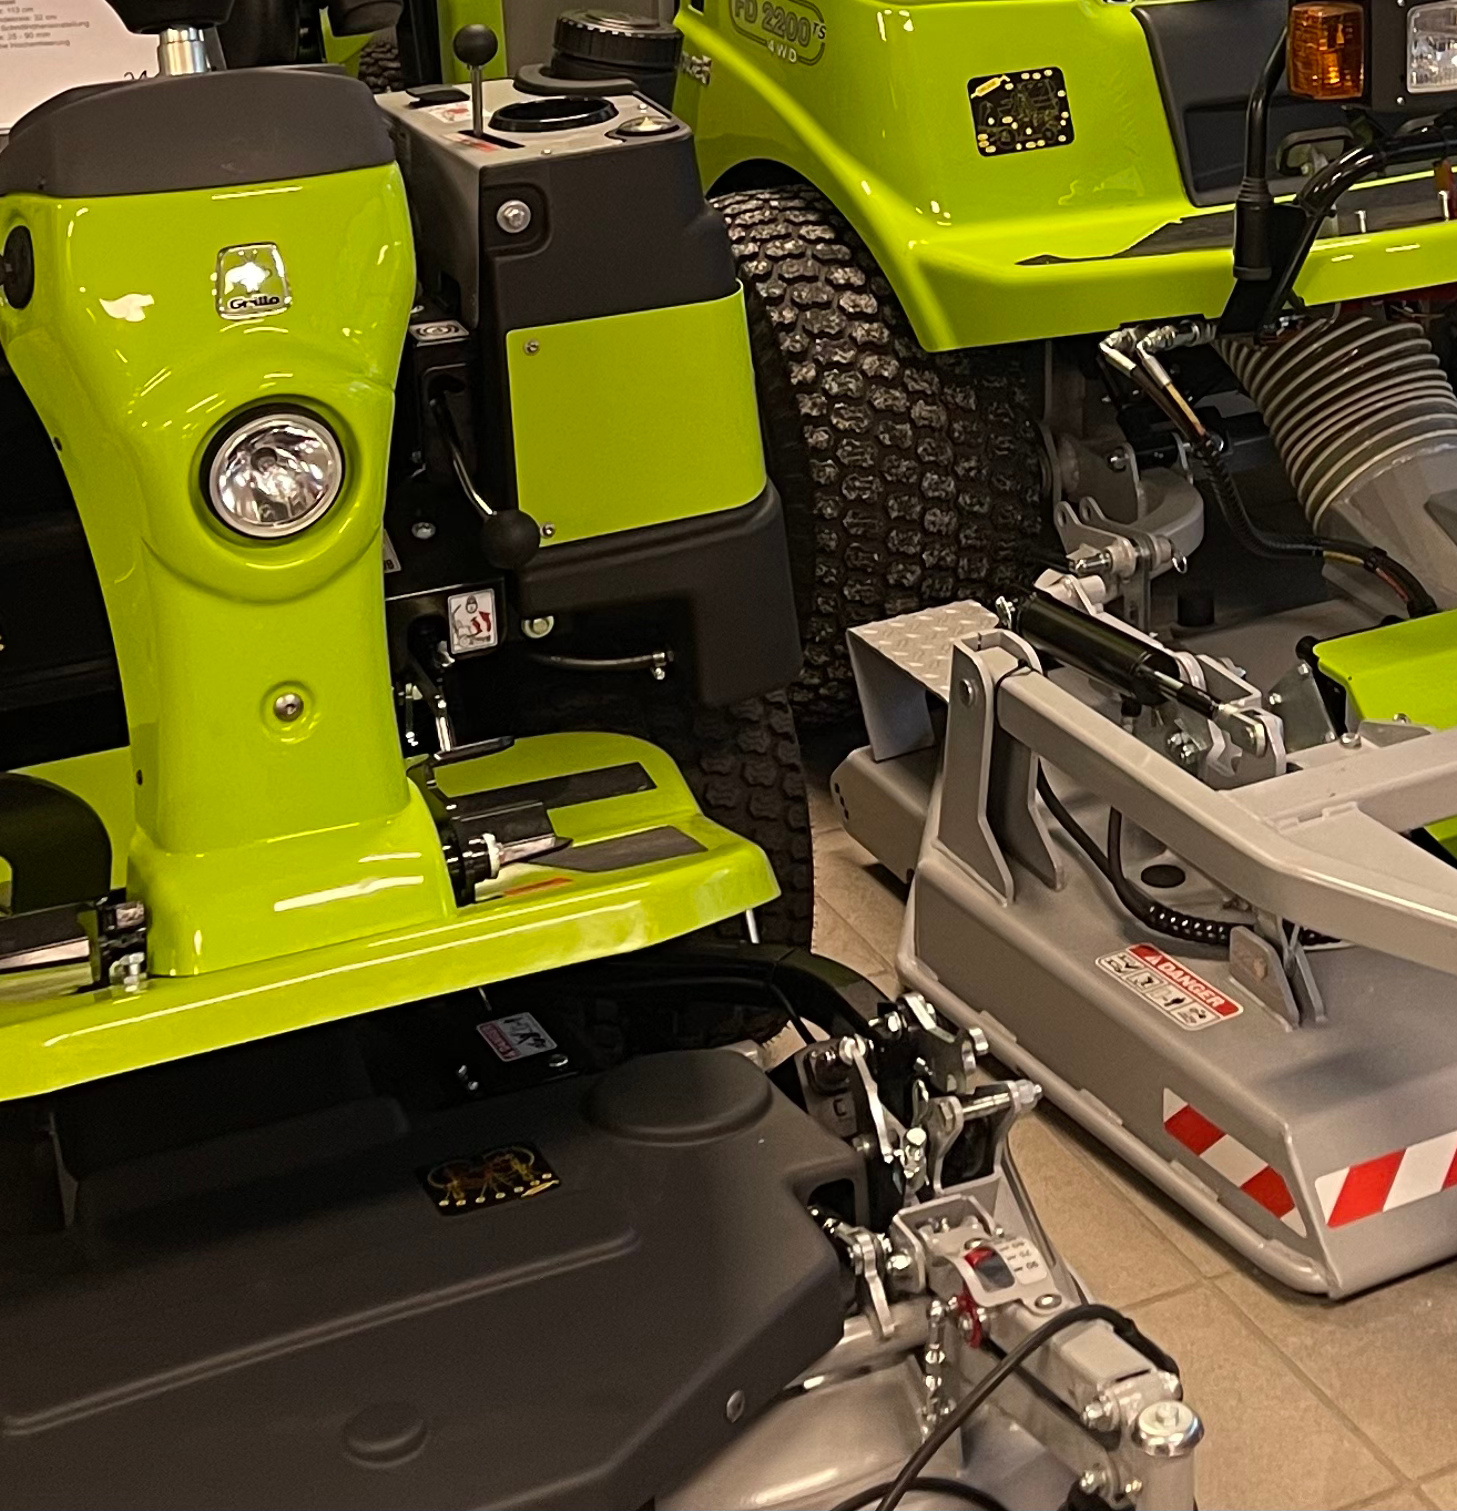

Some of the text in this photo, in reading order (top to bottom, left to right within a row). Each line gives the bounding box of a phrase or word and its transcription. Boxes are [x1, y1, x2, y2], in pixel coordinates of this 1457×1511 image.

[762, 1, 811, 48] 2200
[813, 22, 827, 40] TS
[230, 296, 280, 309] Grillo
[1157, 961, 1226, 1008] DANGER
